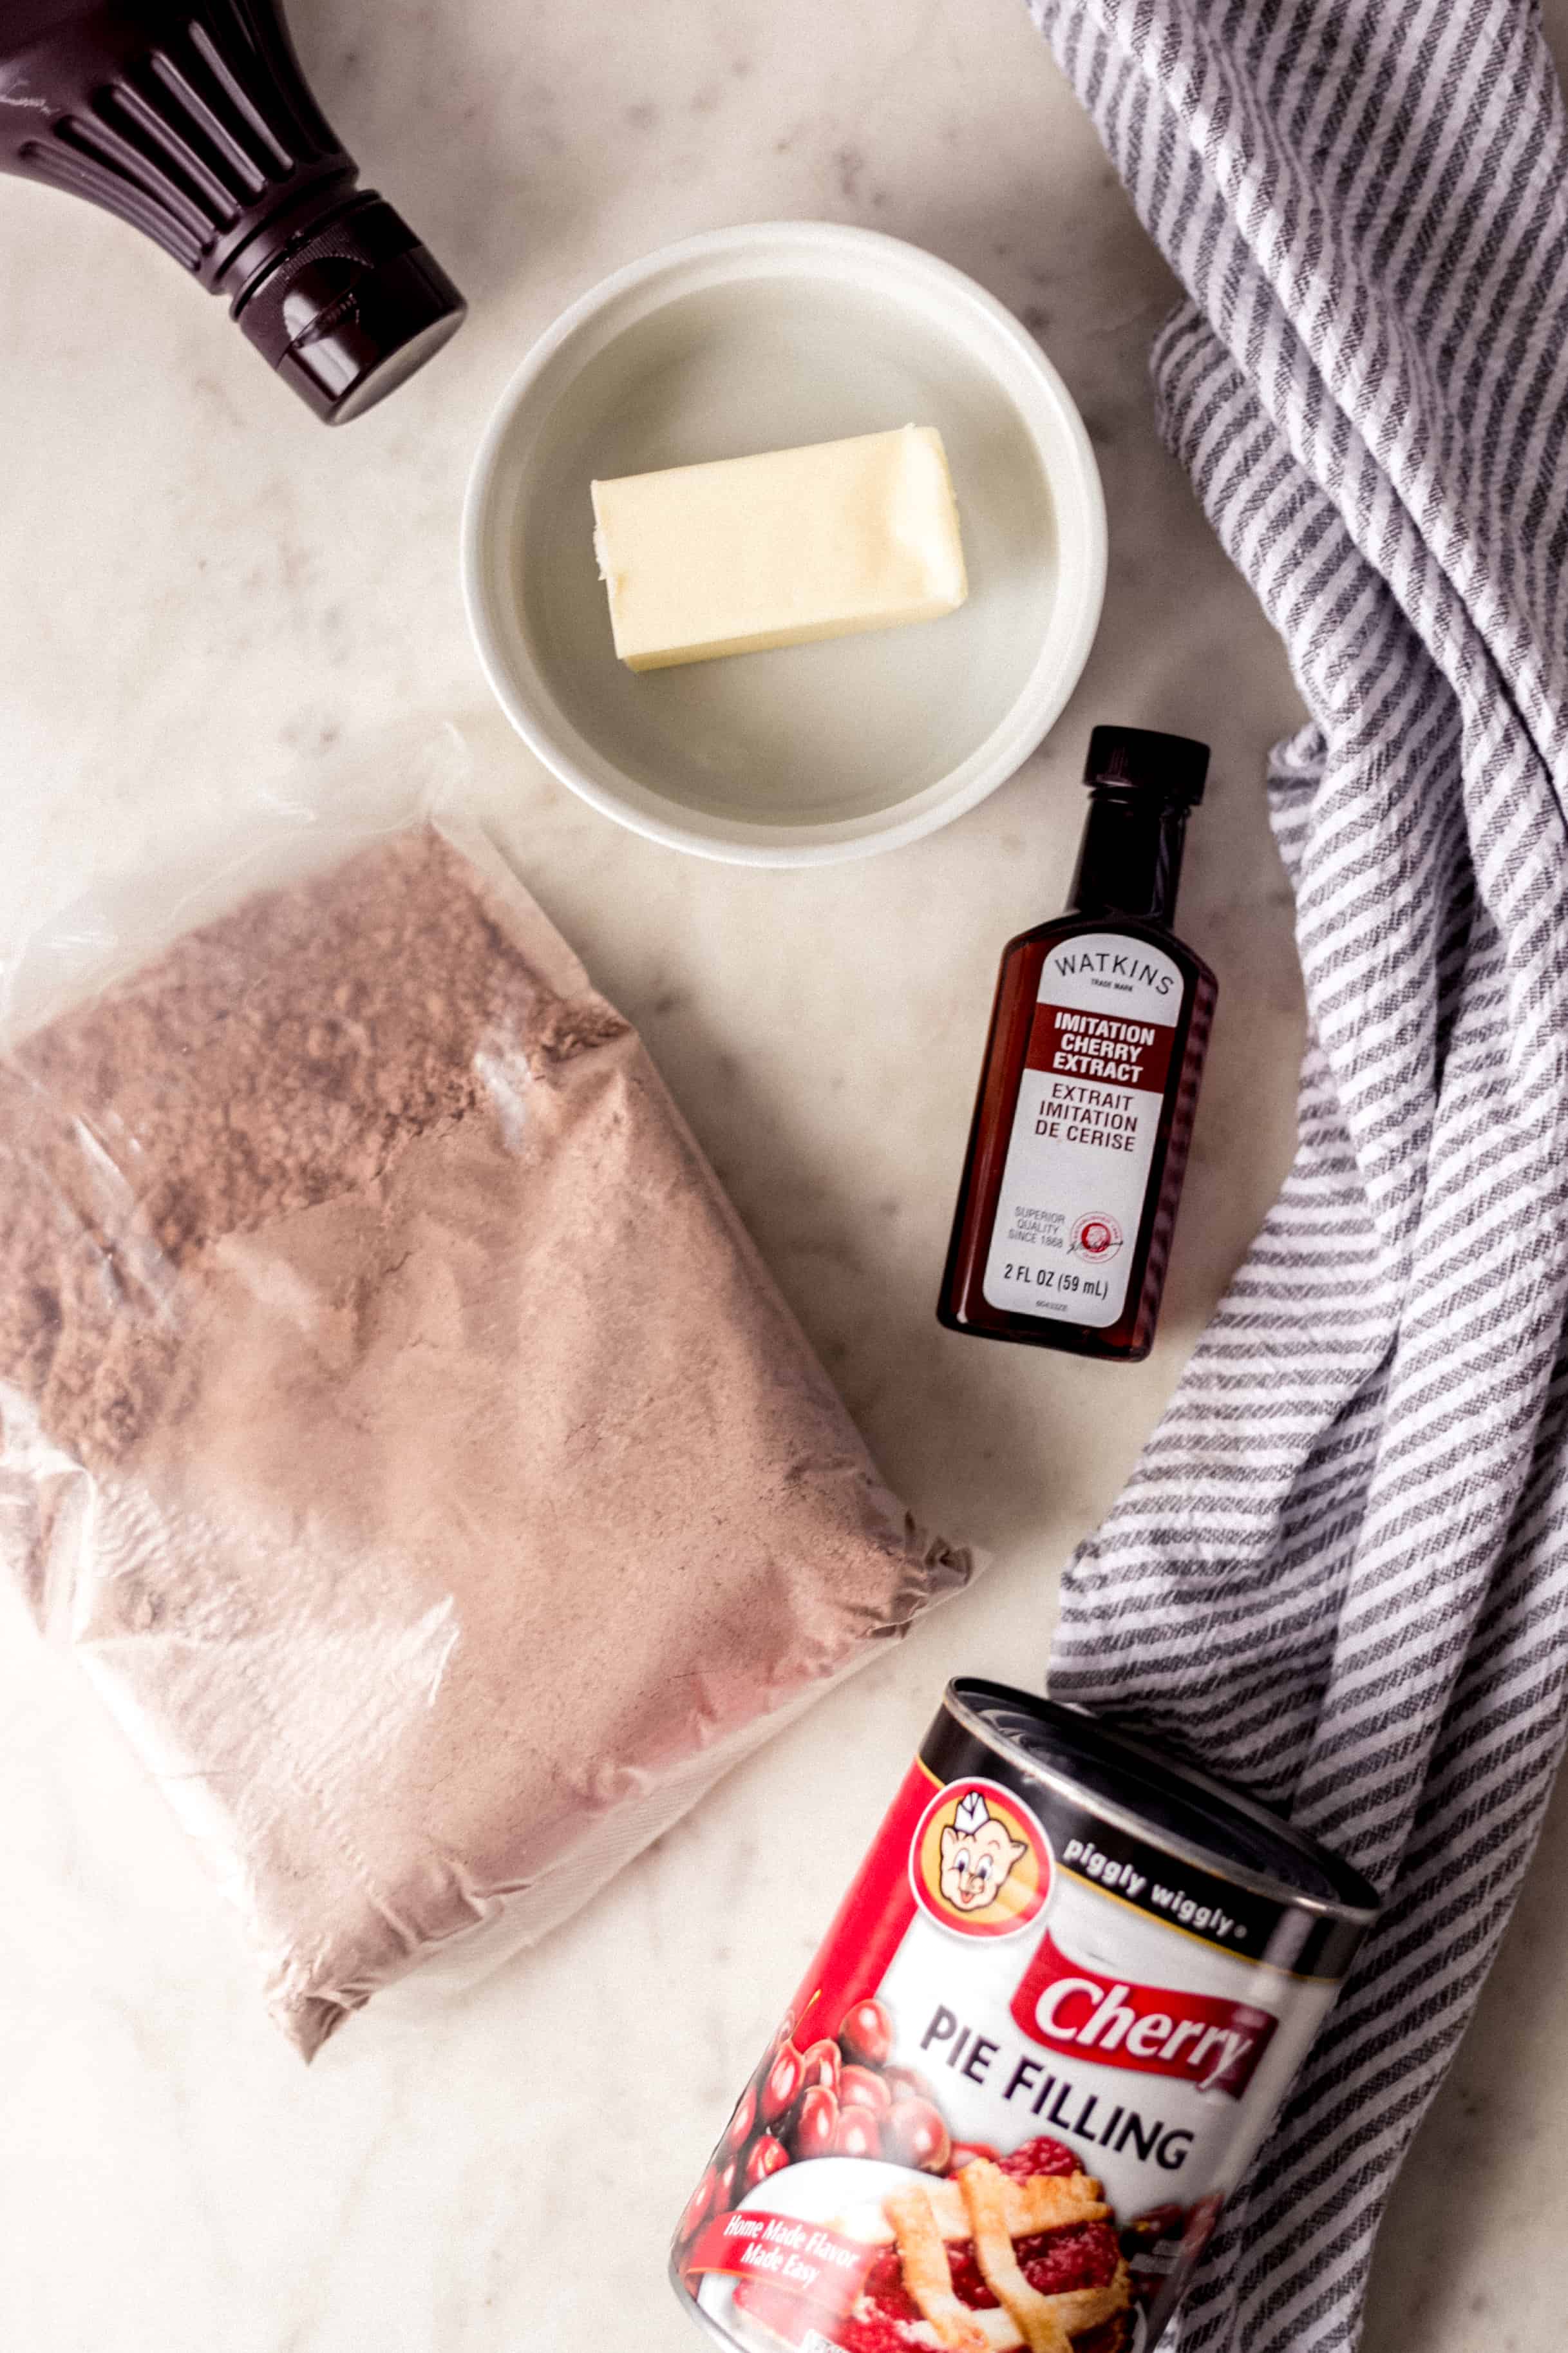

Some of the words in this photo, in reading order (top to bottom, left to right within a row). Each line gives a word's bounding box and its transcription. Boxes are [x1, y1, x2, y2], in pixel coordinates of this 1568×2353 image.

[1055, 953, 1175, 996] WATKINS
[1054, 1012, 1155, 1046] IMITATION
[1061, 1033, 1142, 1063] CHERRY
[1052, 1052, 1143, 1083] EXTRACT
[1052, 1083, 1135, 1111] EXTRAIT
[1039, 1100, 1138, 1132] IMITATION
[1035, 1119, 1059, 1138] DE
[1067, 1125, 1137, 1152] CERISE
[1014, 1206, 1065, 1224] SUPERIOR
[1017, 1218, 1060, 1235] QUALITY
[1008, 1228, 1036, 1244] SINCE
[1004, 1264, 1012, 1280] 2
[1017, 1267, 1031, 1284] FL
[1037, 1270, 1054, 1287] OZ
[1058, 1273, 1079, 1293] (59
[1082, 1280, 1109, 1300] mL)
[1064, 1839, 1148, 1896] piggly
[1034, 1977, 1254, 2091] Cherry
[920, 2004, 999, 2086] PIE
[1003, 2055, 1194, 2170] FILLING
[723, 2215, 762, 2239] Home
[763, 2218, 806, 2249] Made
[806, 2231, 860, 2268] Flavor
[741, 2242, 782, 2271] Made
[784, 2253, 820, 2289] Easy
